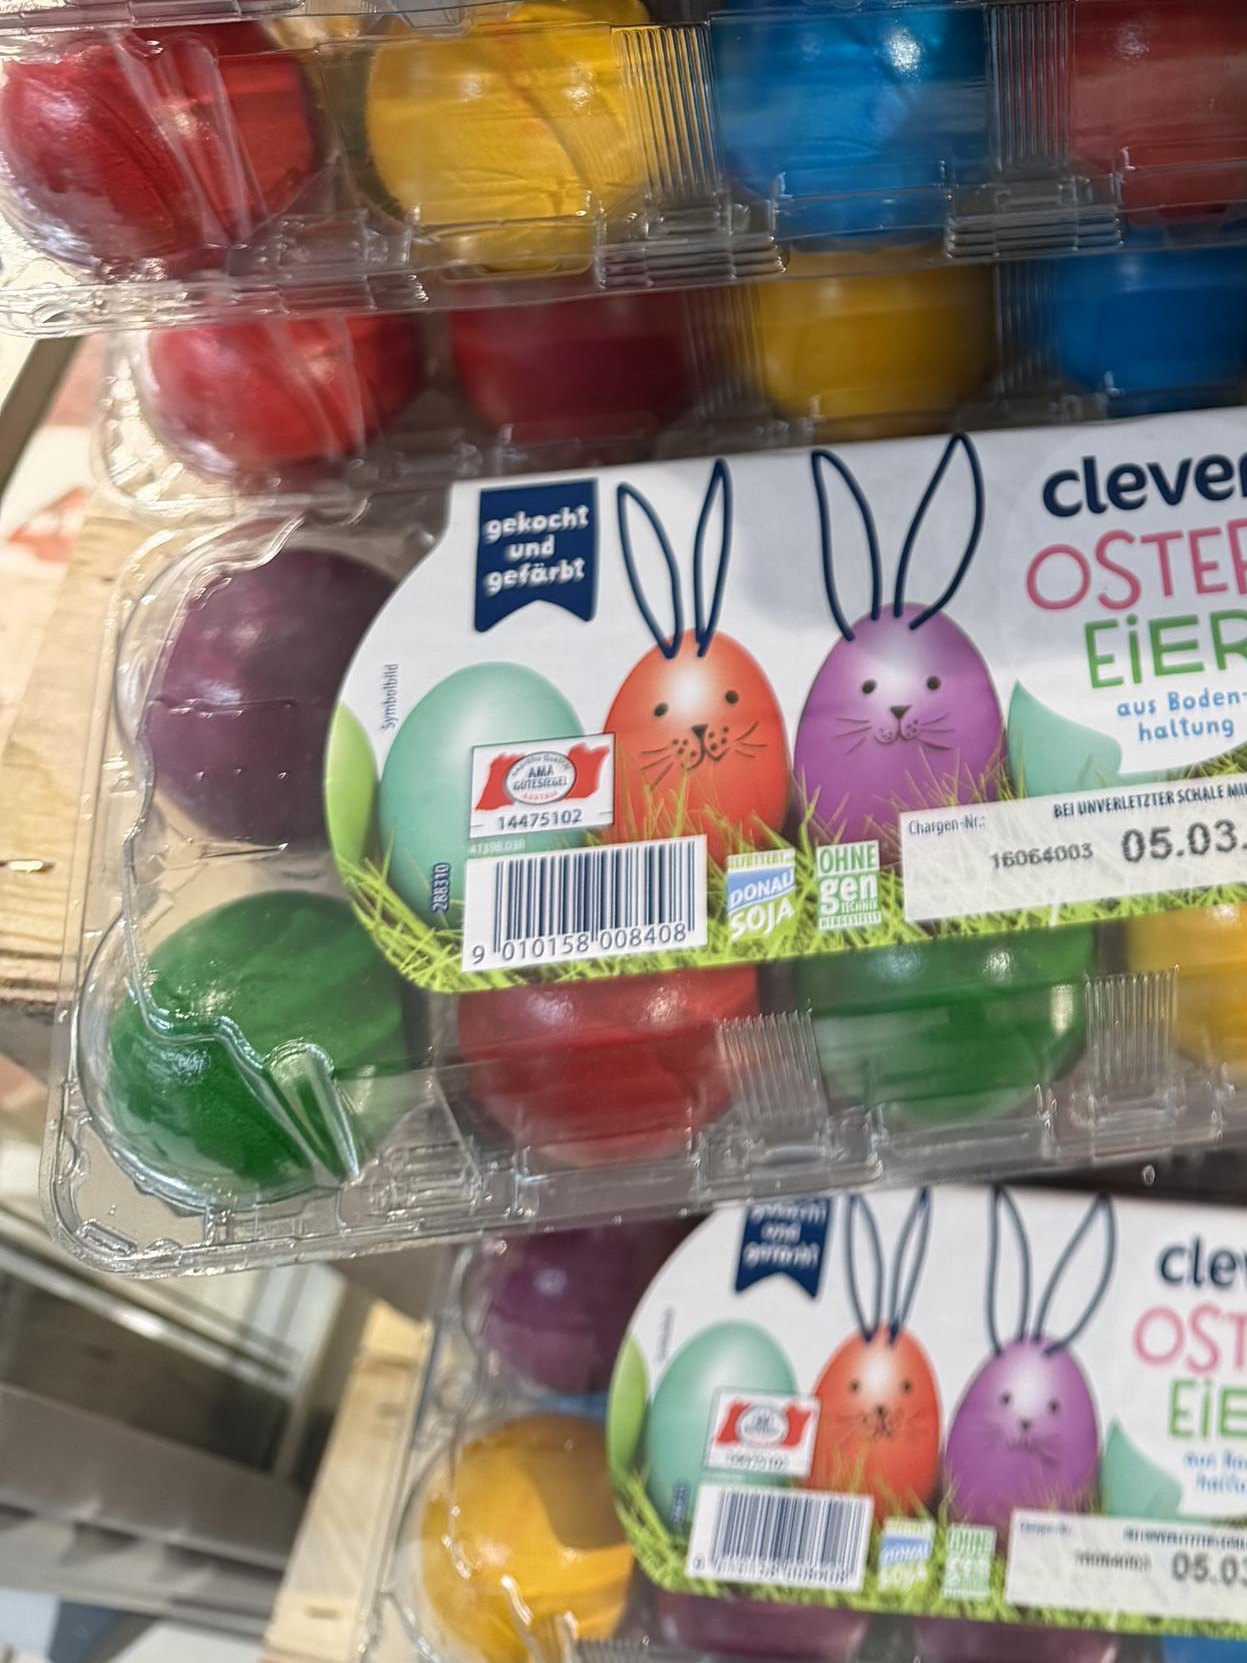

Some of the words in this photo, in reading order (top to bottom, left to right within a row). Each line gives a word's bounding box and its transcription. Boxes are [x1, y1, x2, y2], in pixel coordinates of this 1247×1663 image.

[485, 505, 589, 539] gekocht
[510, 538, 555, 559] und
[486, 560, 585, 596] gefärbt
[381, 663, 399, 730] Symbolbild
[1116, 694, 1158, 719] aus
[1138, 713, 1236, 745] haltung
[1053, 803, 1075, 819] BEI
[1077, 789, 1176, 816] UNVERLETZTER
[1177, 785, 1225, 804] SCHALE
[498, 809, 583, 830] 14475102
[908, 815, 986, 836] Chargen-Nr.:
[819, 844, 876, 874] OHNE
[990, 843, 1094, 869] 16064003
[730, 868, 795, 910] DONAU
[819, 874, 878, 914] gen
[729, 900, 796, 940] SOJA
[472, 945, 485, 964] 9
[502, 934, 590, 961] 010158
[600, 923, 686, 950] 008408
